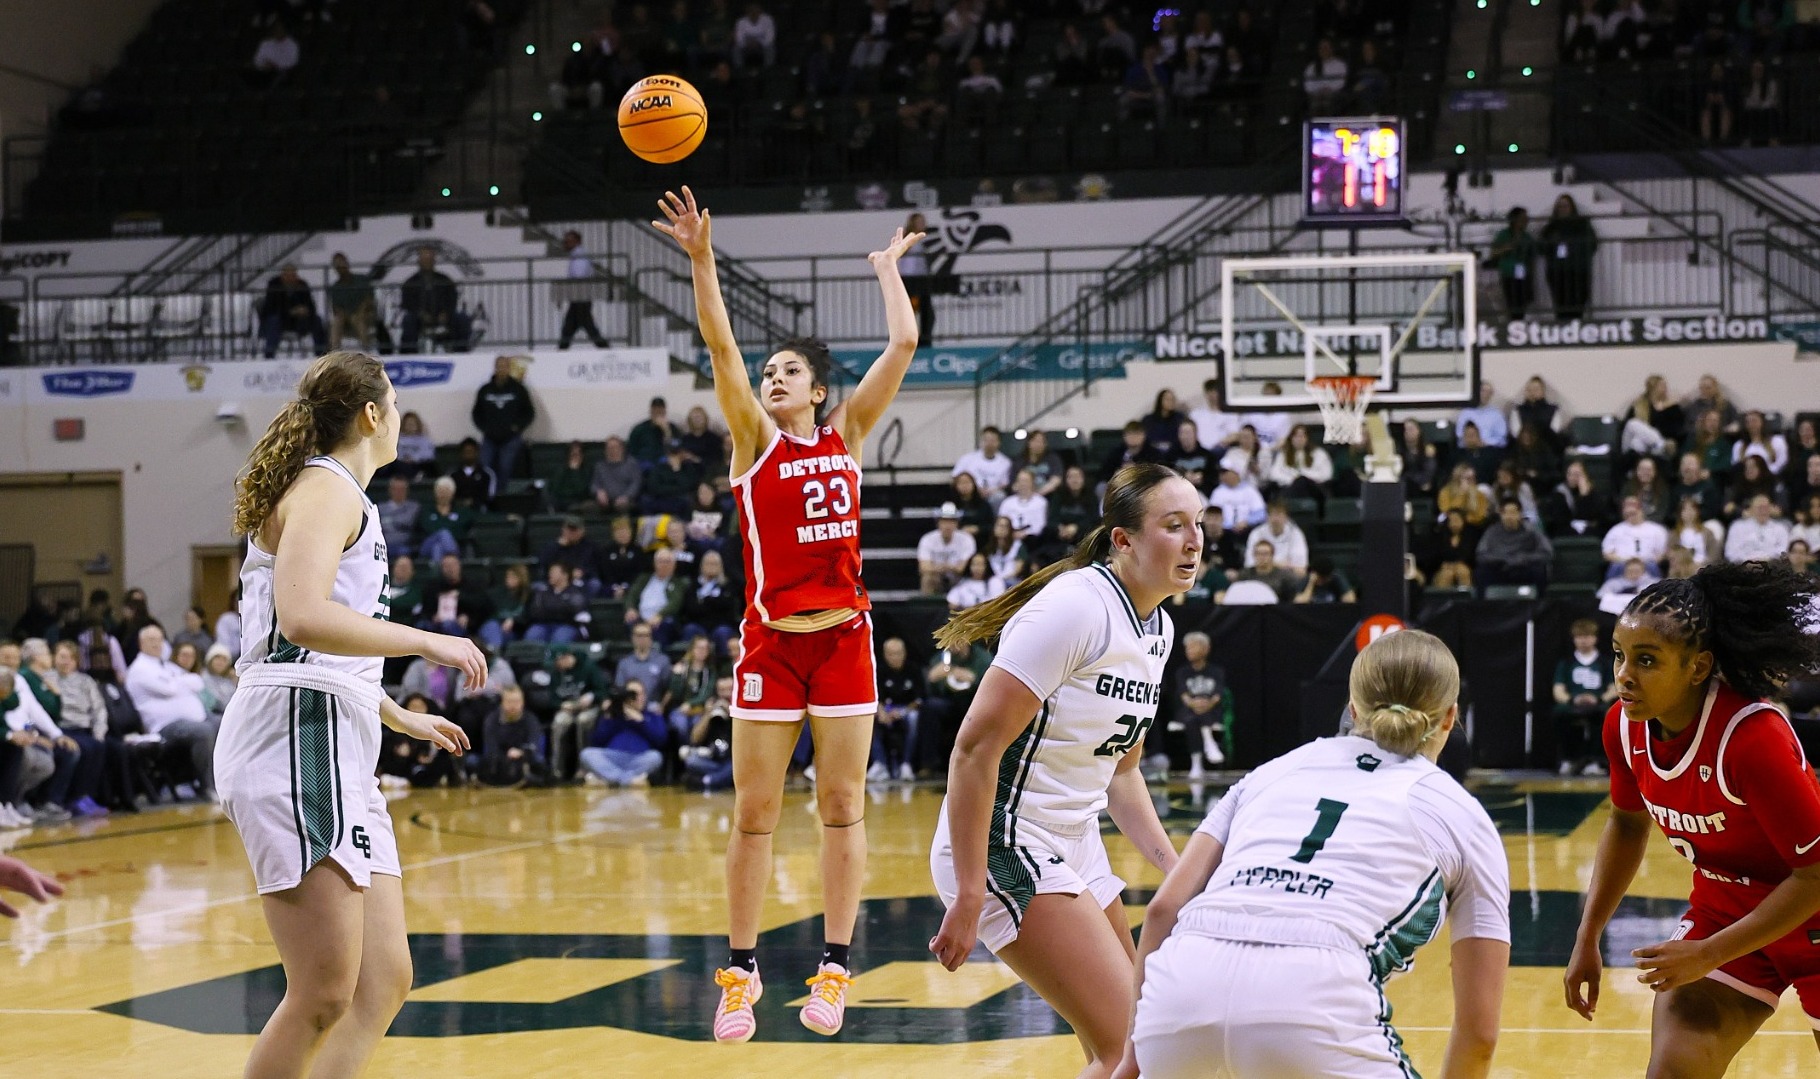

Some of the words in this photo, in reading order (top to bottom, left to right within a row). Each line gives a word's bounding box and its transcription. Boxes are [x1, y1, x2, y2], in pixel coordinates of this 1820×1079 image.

[630, 95, 673, 114] NCAA
[1155, 333, 1267, 358] Nicoet
[1506, 319, 1633, 346] Student
[1642, 316, 1768, 341] Section
[932, 352, 980, 377] Clips
[803, 476, 852, 519] 23
[1095, 673, 1153, 705] GREEN
[1093, 713, 1153, 757] 20
[1287, 797, 1349, 864] 1
